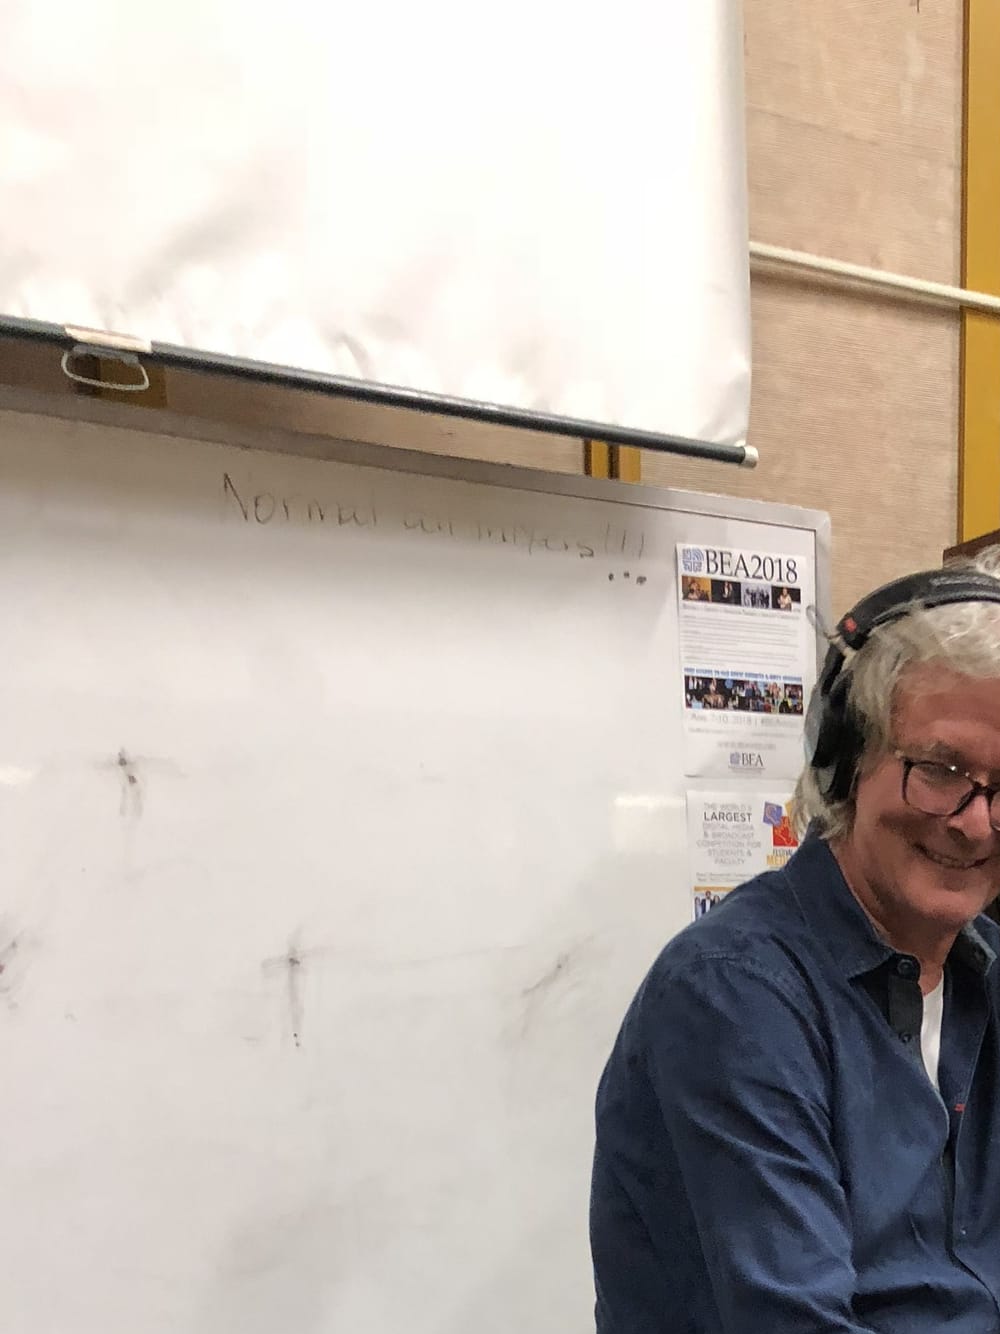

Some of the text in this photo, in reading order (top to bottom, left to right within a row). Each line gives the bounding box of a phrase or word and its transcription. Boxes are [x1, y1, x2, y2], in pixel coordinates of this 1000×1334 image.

[704, 548, 798, 584] BEA2018
[741, 752, 764, 767] BEA
[703, 811, 752, 823] LARGEST
